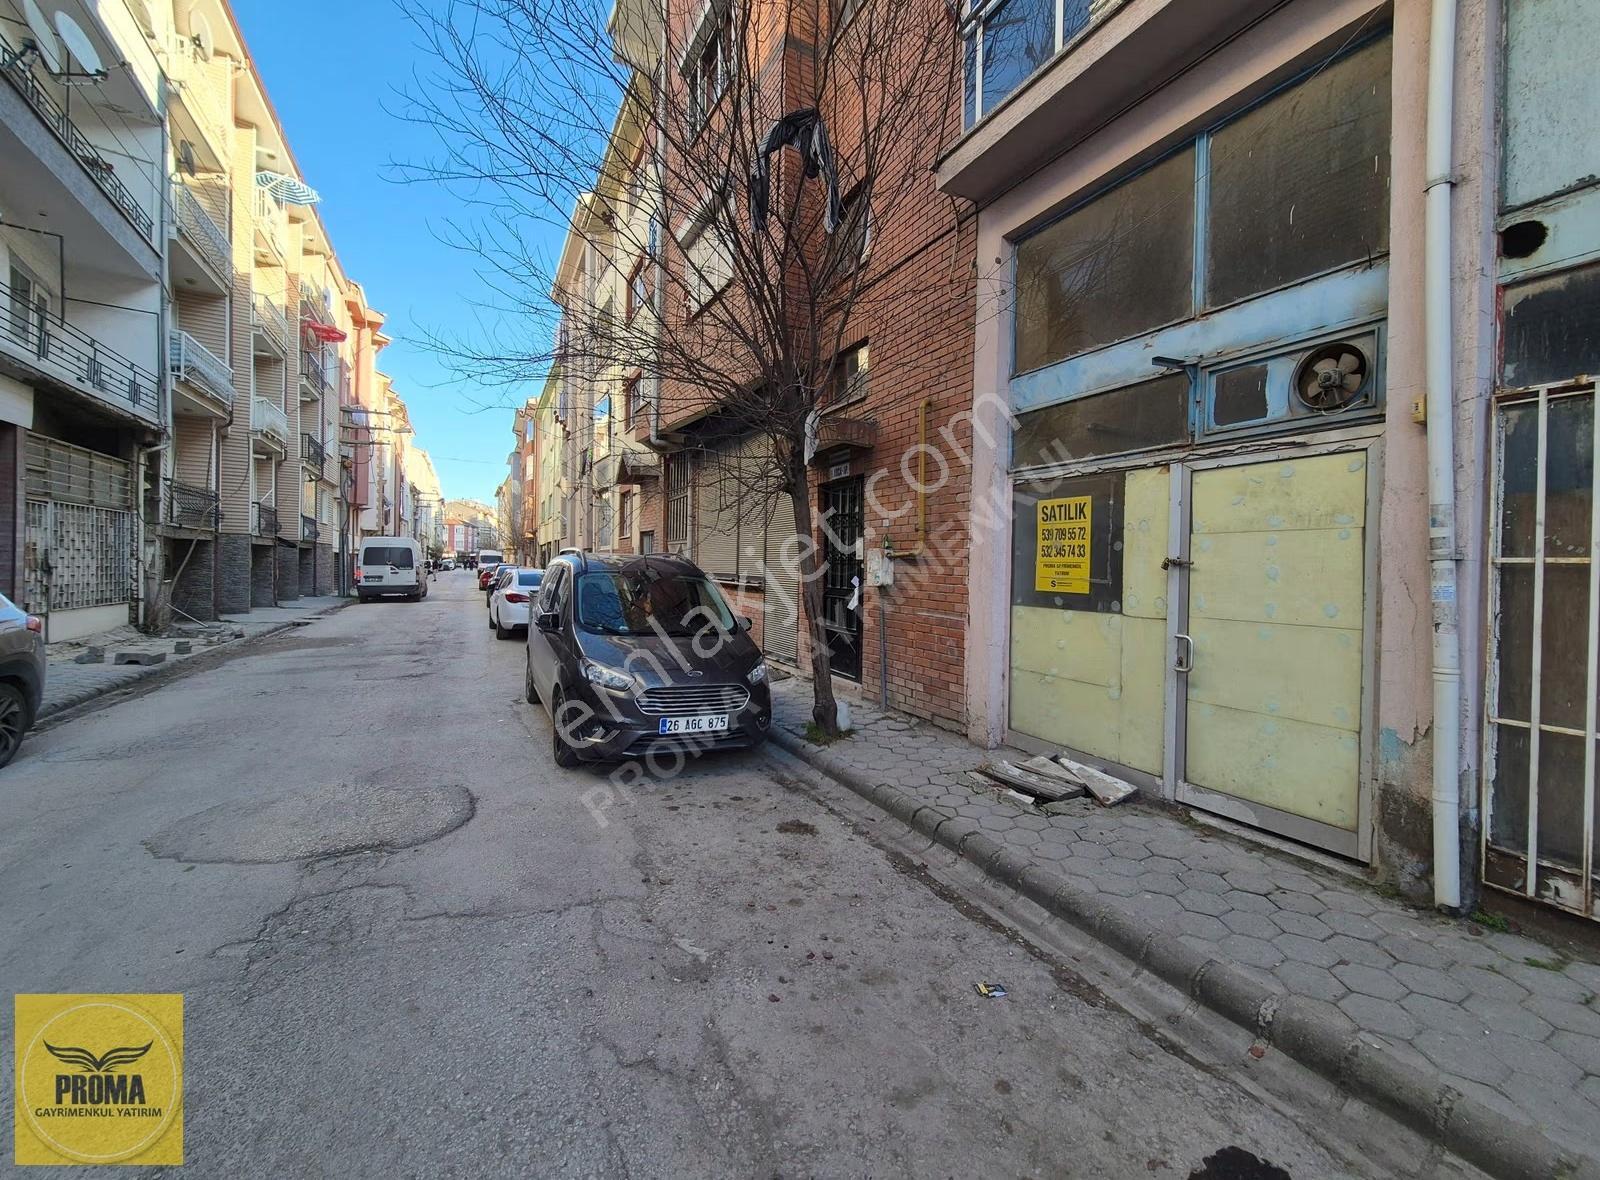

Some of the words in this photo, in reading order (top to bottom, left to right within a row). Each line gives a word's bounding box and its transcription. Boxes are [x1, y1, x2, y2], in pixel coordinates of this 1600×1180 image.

[1041, 502, 1087, 522] SATILIK
[1055, 527, 1066, 541] 709
[1078, 526, 1086, 540] 72
[1041, 545, 1053, 558] 532
[1054, 544, 1066, 558] 345
[1067, 544, 1075, 558] 74
[1077, 544, 1086, 558] 33
[667, 720, 679, 731] 26
[685, 718, 703, 730] AGC
[708, 716, 726, 729] 875
